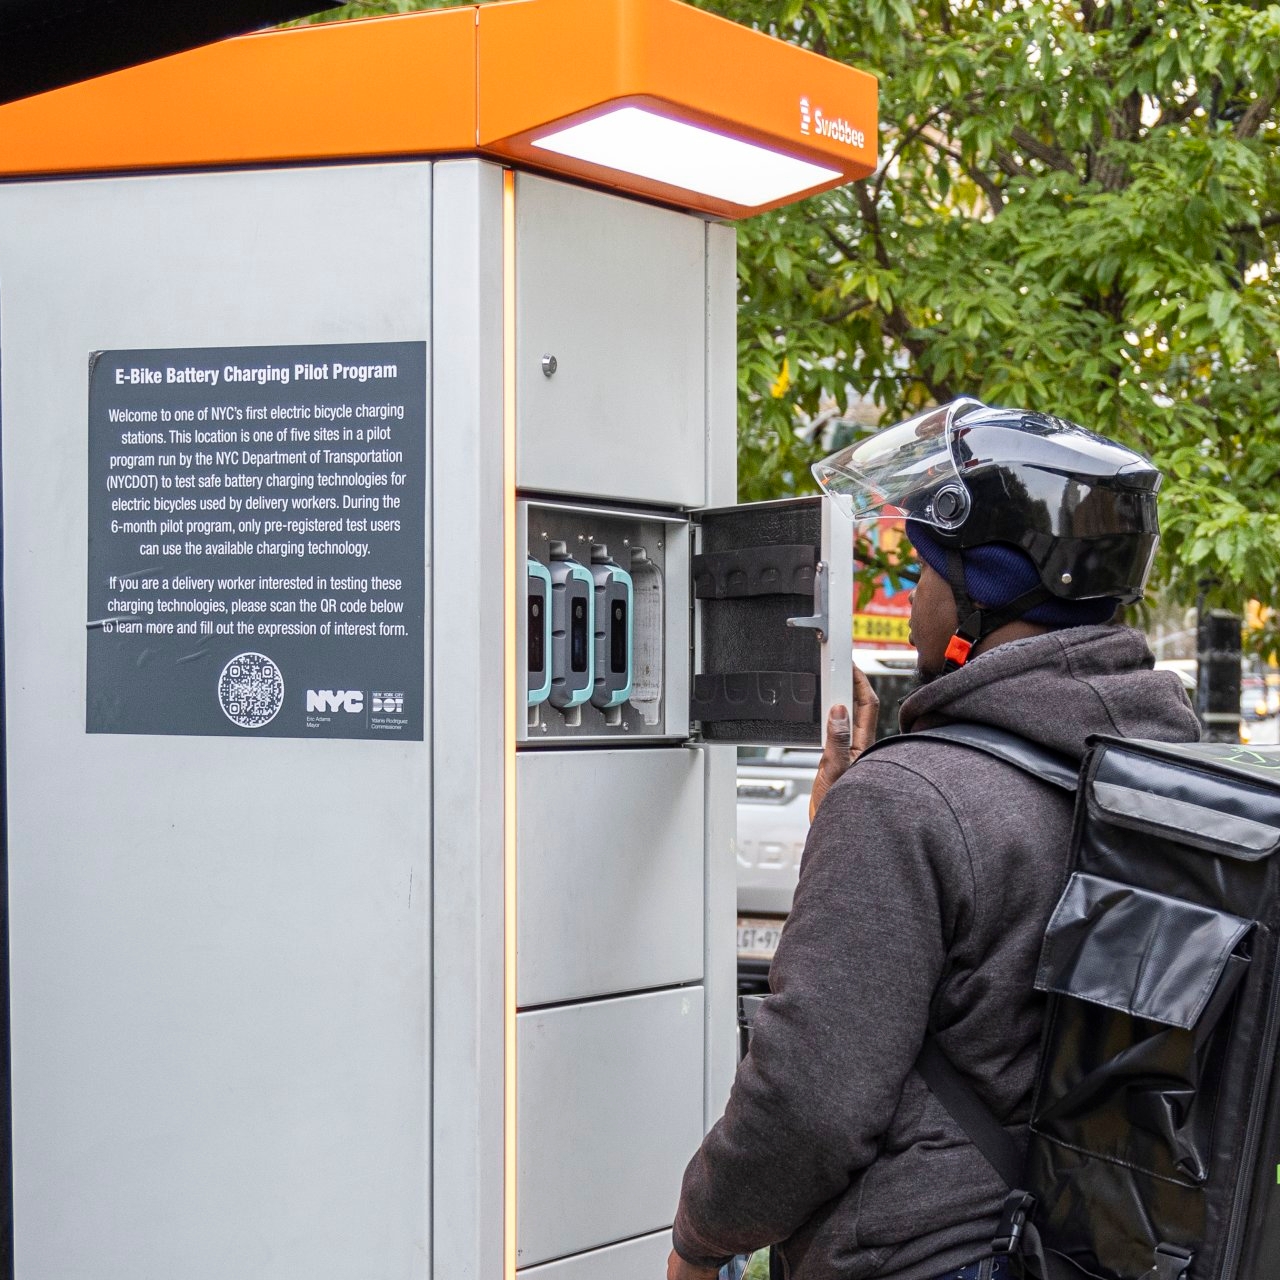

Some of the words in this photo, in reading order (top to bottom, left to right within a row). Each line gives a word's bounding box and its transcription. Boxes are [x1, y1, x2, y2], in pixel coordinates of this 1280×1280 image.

[815, 109, 865, 149] Swobbee
[115, 368, 162, 383] E-Bike
[166, 368, 219, 384] Battery
[223, 365, 289, 384] Charging
[294, 364, 328, 379] Pilot
[332, 364, 397, 381] Program
[108, 409, 157, 421] Welcome
[160, 409, 171, 421] to
[174, 410, 194, 420] one
[197, 407, 208, 420] of
[211, 406, 242, 420] NYC's
[246, 406, 267, 419] first
[270, 405, 310, 418] electric
[314, 405, 352, 420] bicycle
[355, 404, 404, 419] charging
[121, 431, 166, 444] stations.
[168, 430, 191, 442] This
[195, 430, 237, 442] location
[240, 429, 249, 442] is
[253, 431, 273, 441] one
[276, 428, 287, 441] of
[290, 428, 310, 440] five
[313, 428, 339, 440] sites
[343, 427, 352, 440] in
[356, 429, 363, 440] a
[366, 426, 390, 442] pilot
[110, 456, 154, 468] program
[158, 455, 176, 465] run
[179, 452, 192, 468] by
[195, 452, 212, 465] the
[216, 451, 238, 464] NYC
[242, 451, 306, 466] Department
[309, 450, 320, 463] of
[323, 449, 402, 464] Transportation
[106, 475, 158, 490] (NYCDOT)
[161, 475, 172, 488] to
[174, 475, 195, 487] test
[198, 474, 221, 487] safe
[224, 474, 262, 489] battery
[266, 473, 314, 488] charging
[317, 472, 387, 488] technologies
[390, 472, 406, 484] for
[112, 498, 150, 510] electric
[154, 497, 196, 512] bicycles
[200, 497, 225, 509] used
[229, 496, 241, 512] by
[246, 496, 287, 511] delivery
[292, 496, 339, 508] workers.
[343, 495, 378, 510] During
[383, 495, 399, 508] the
[111, 520, 156, 532] 6-month
[160, 519, 183, 534] pilot
[186, 521, 235, 534] program,
[238, 519, 261, 534] only
[264, 518, 342, 534] pre-registered
[346, 518, 367, 531] test
[370, 520, 400, 531] users
[139, 544, 159, 554] can
[162, 544, 181, 554] use
[184, 542, 202, 554] the
[205, 541, 253, 554] available
[256, 541, 304, 556] charging
[307, 541, 370, 556] technology.
[109, 576, 117, 588] If
[119, 579, 138, 592] you
[141, 579, 159, 589] are
[162, 579, 169, 589] a
[171, 576, 214, 592] delivery
[217, 576, 255, 589] worker
[258, 576, 313, 589] interested
[316, 576, 326, 589] in
[330, 576, 367, 592] testing
[370, 576, 401, 589] these
[107, 598, 153, 614] charging
[157, 599, 227, 614] technologies,
[231, 599, 266, 614] please
[270, 601, 295, 611] scan
[299, 599, 316, 612] the
[320, 598, 336, 612] QR
[340, 599, 366, 612] code
[370, 599, 403, 612] below
[103, 622, 113, 635] to
[115, 622, 142, 632] learn
[146, 623, 173, 633] more
[176, 621, 196, 633] and
[200, 621, 212, 633] fill
[216, 621, 233, 634] out
[237, 621, 254, 634] the
[257, 622, 316, 636] expression
[320, 621, 330, 634] of
[334, 622, 376, 635] interest
[379, 622, 408, 635] form.
[307, 690, 363, 712] NYC
[373, 699, 403, 712] DOT
